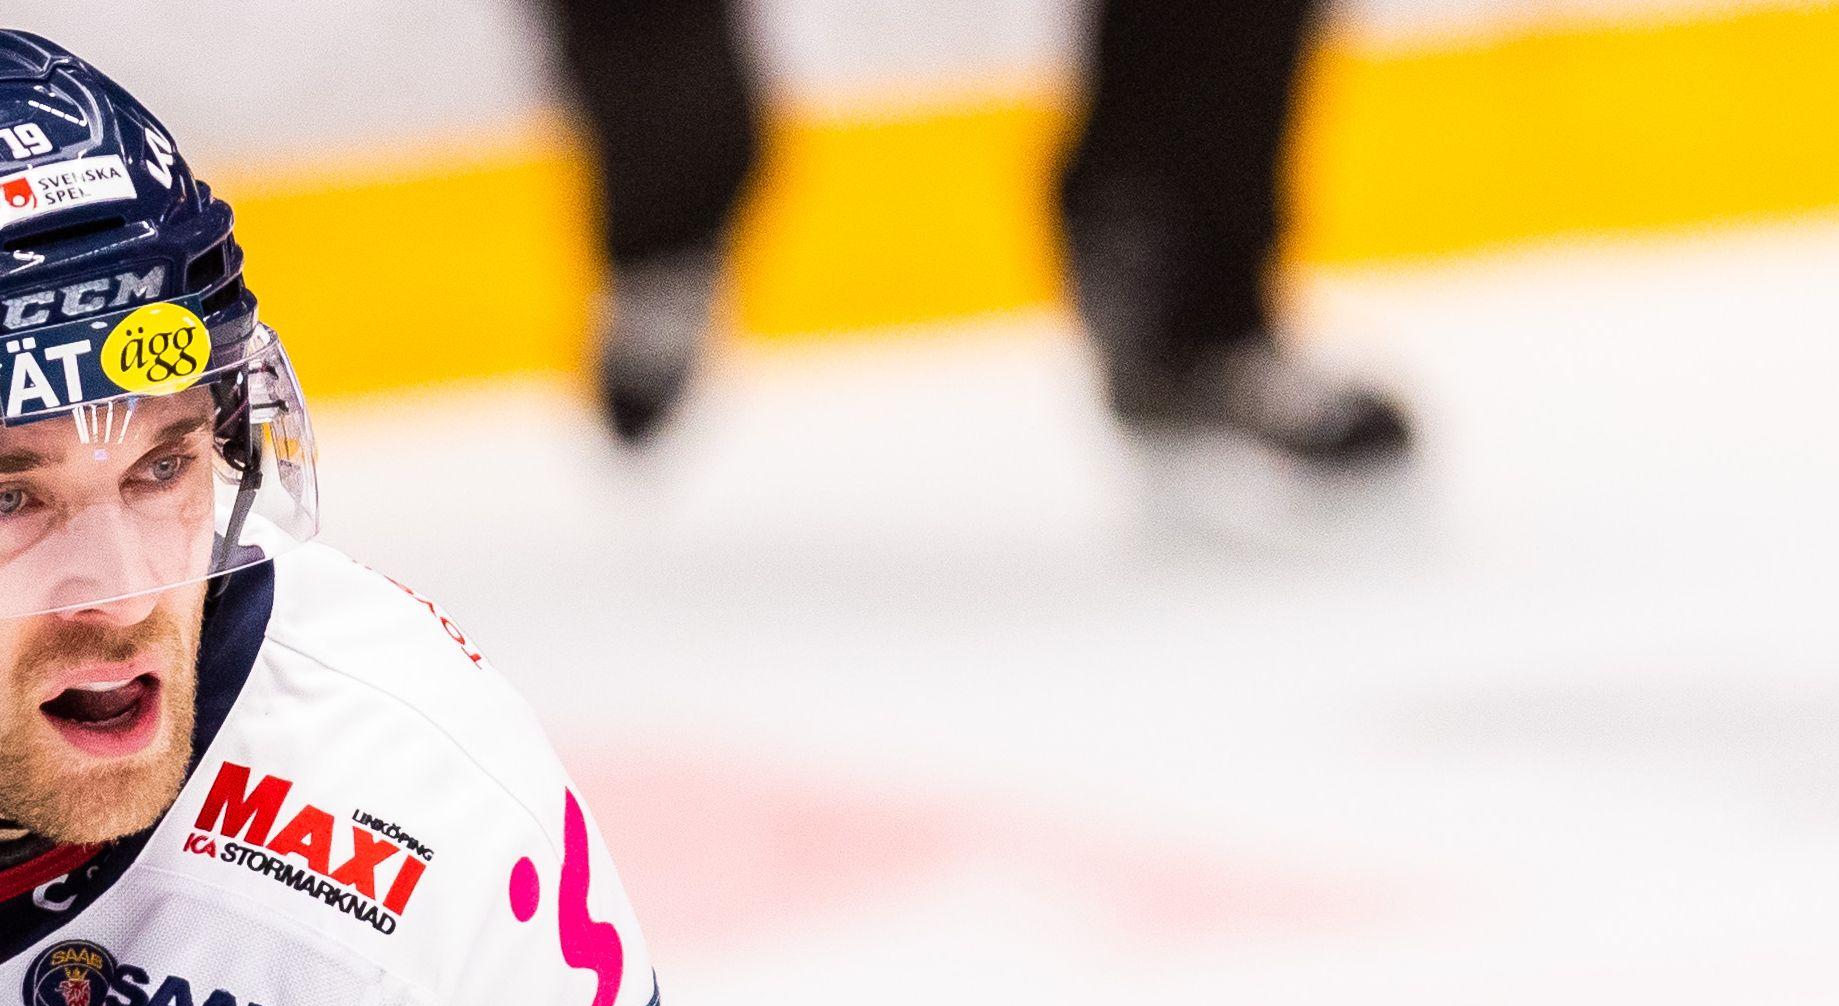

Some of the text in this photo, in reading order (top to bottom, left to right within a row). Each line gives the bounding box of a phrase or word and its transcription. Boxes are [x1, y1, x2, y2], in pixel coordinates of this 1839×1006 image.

[1, 265, 166, 330] CCM
[6, 326, 197, 418] ÄT ägg
[193, 760, 428, 918] MAXI
[351, 808, 435, 863] LINKÖPING
[182, 832, 398, 936] ICA STORMARKNAD
[50, 947, 104, 970] SAAB
